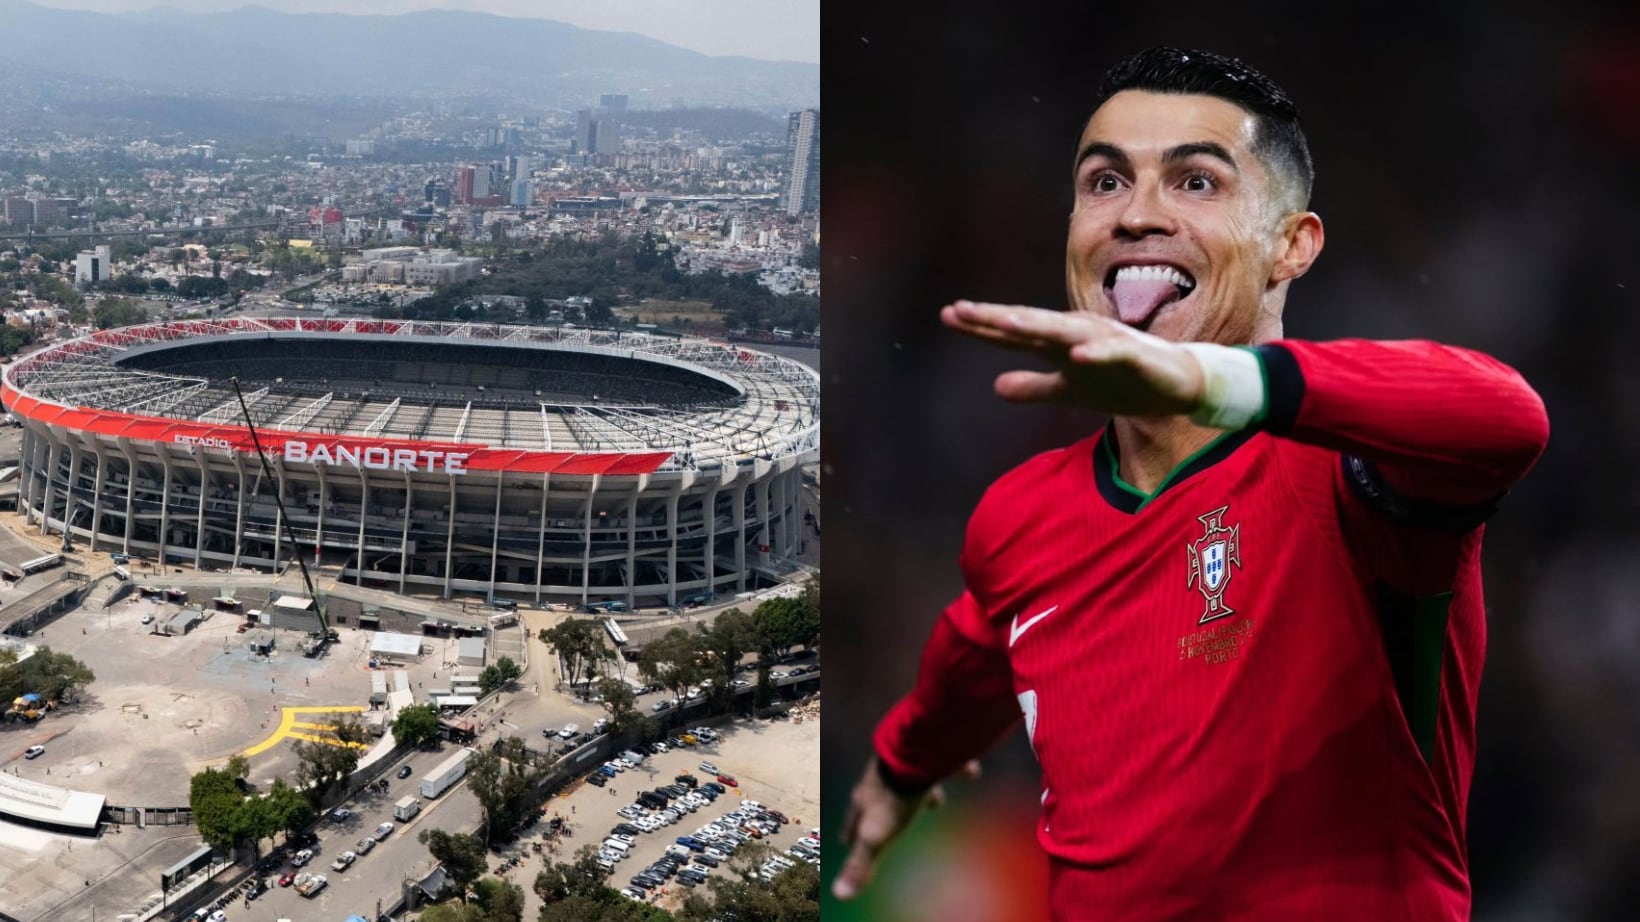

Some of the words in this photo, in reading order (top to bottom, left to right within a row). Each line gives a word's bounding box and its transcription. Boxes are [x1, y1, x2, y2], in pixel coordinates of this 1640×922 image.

[174, 434, 229, 448] ESTADIO
[284, 441, 469, 475] BANORTE
[1177, 627, 1217, 648] PORTUGAL
[1188, 635, 1239, 659] NOVEMBRO
[1204, 647, 1239, 665] PORTO
